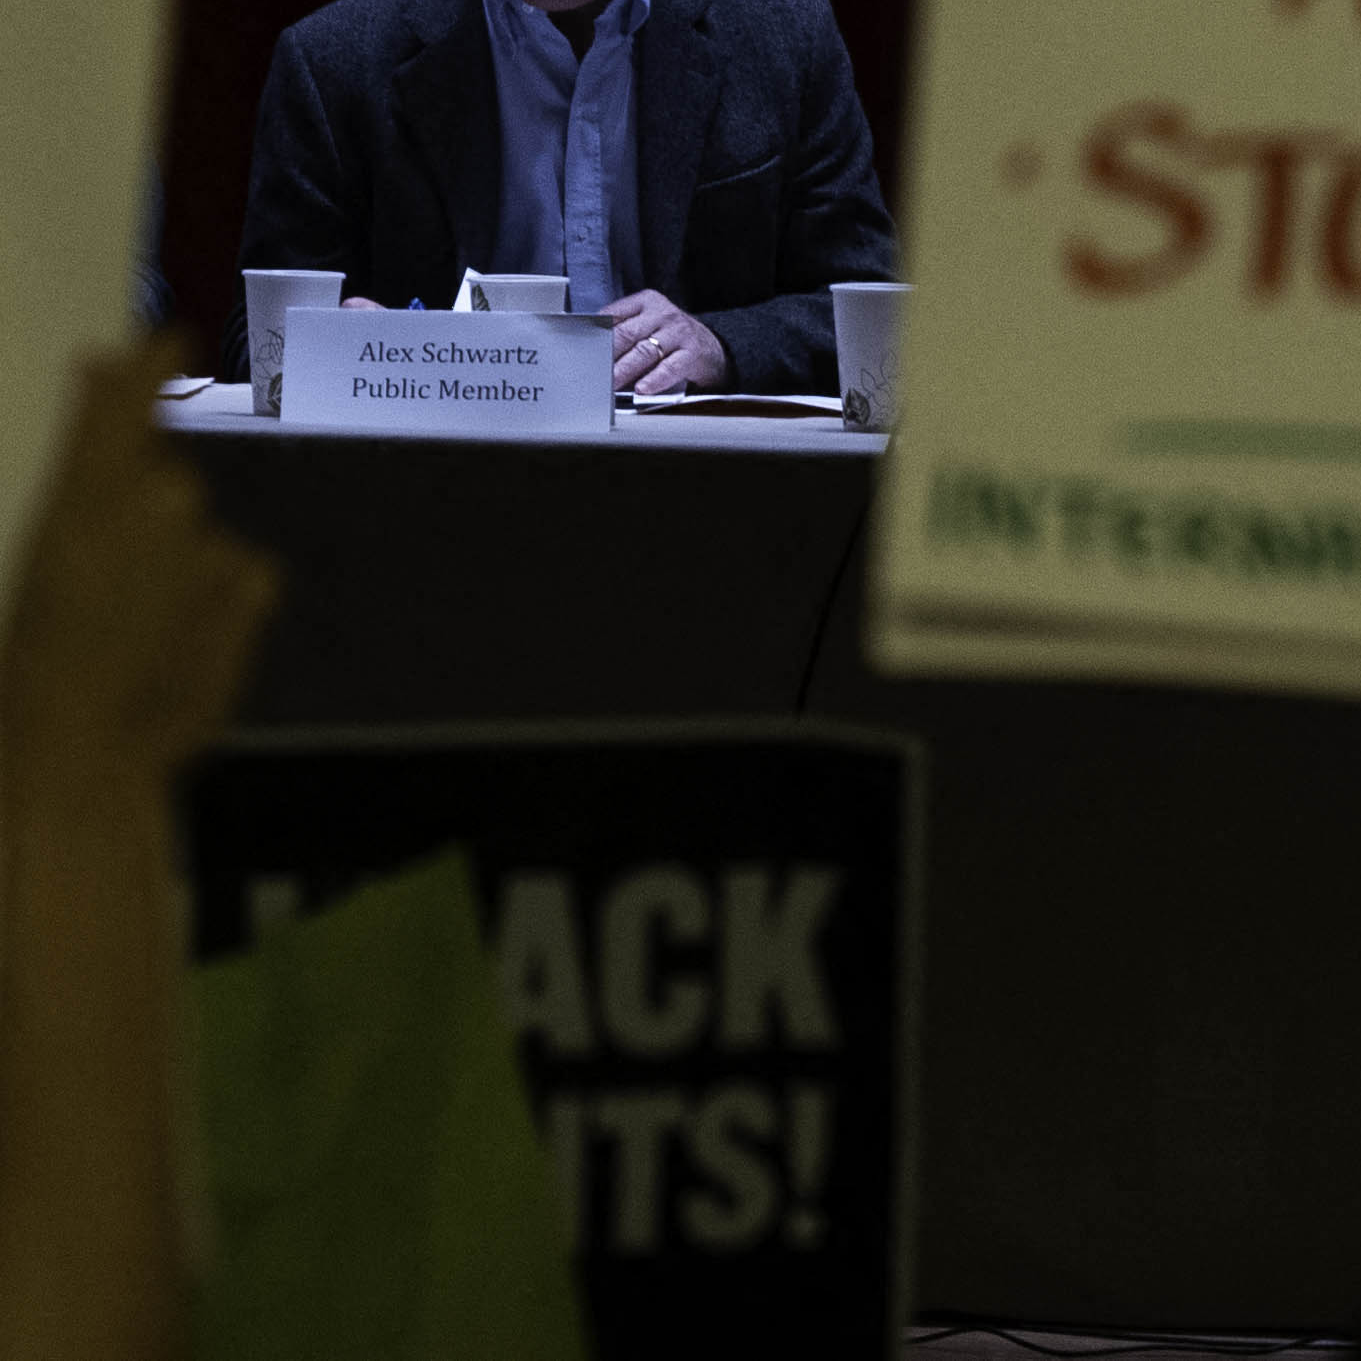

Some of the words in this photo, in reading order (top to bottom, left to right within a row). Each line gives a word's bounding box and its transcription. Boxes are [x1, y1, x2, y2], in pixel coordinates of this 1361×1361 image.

[359, 341, 414, 363] Alex
[422, 342, 539, 365] Schwartz
[352, 377, 431, 399] Public
[439, 379, 544, 402] Member
[497, 864, 843, 1057] ACK
